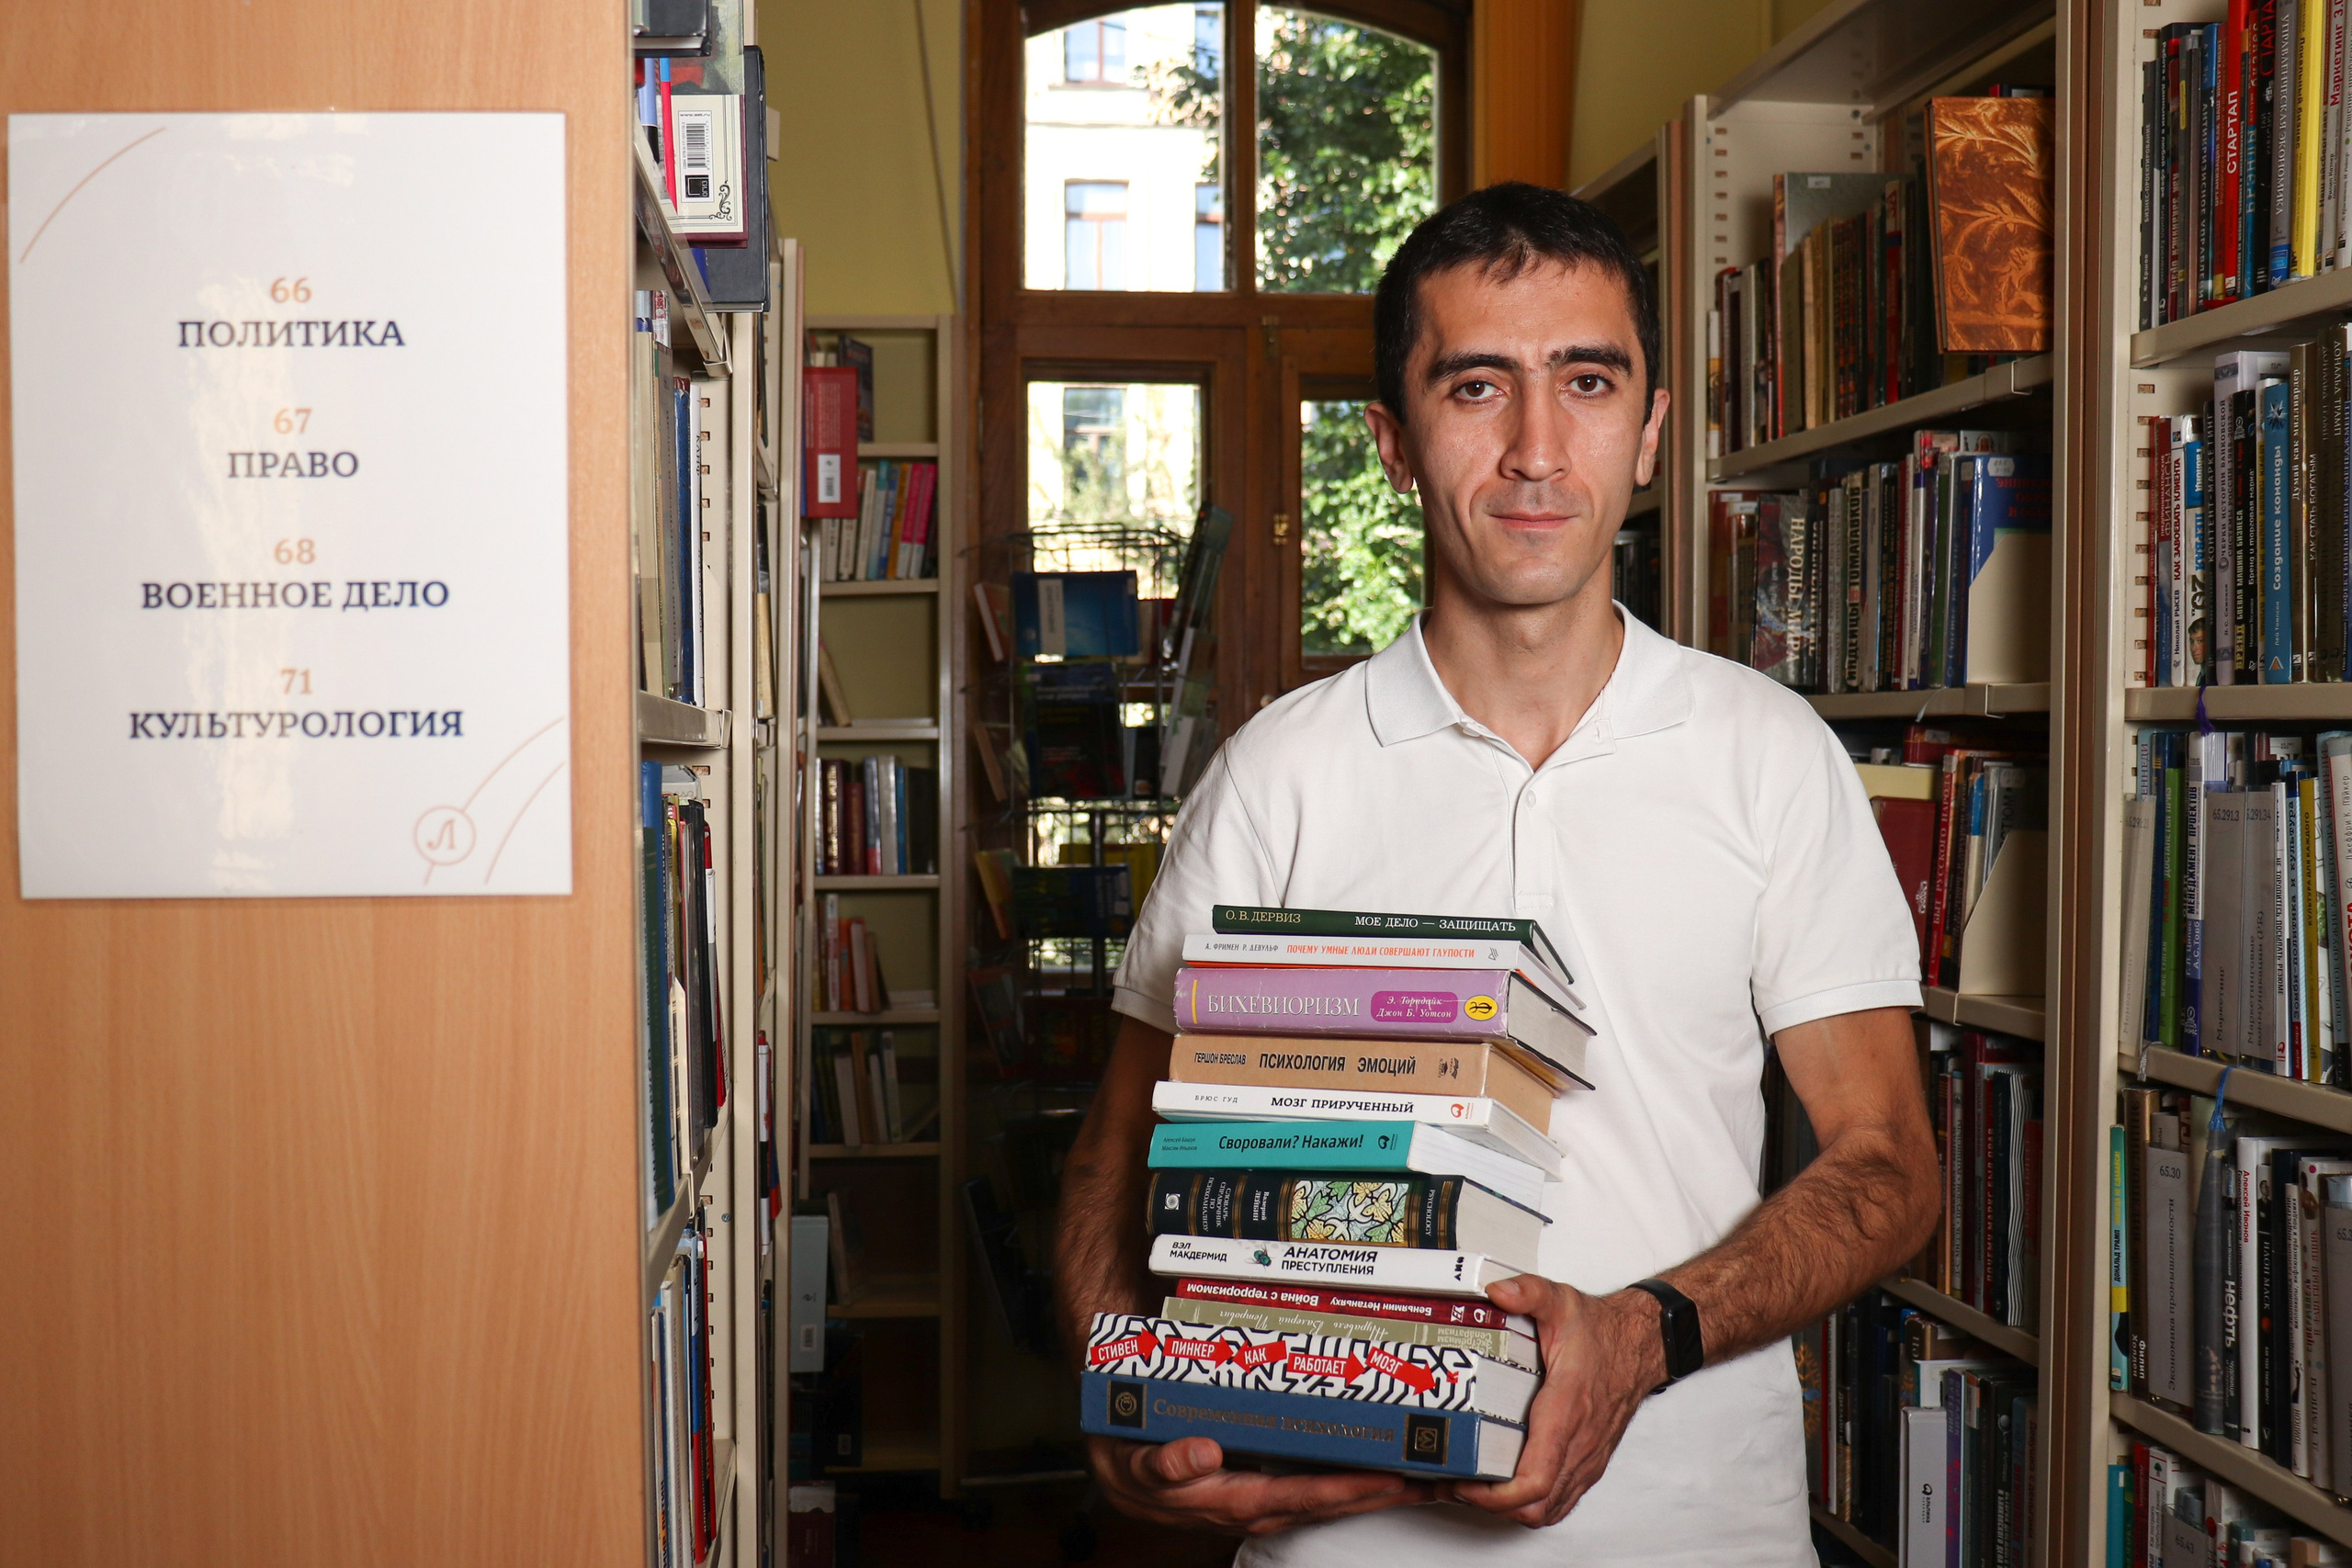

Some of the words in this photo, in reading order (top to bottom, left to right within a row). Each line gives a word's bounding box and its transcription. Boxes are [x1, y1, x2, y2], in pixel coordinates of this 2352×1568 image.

[2278, 14, 2290, 129] УПРАВЛЕНЧЕСКАЯ
[2329, 24, 2344, 107] Маркетинг
[2227, 90, 2239, 175] СТАРТАП
[2200, 103, 2209, 217] АНТИКРИЗИСНОЕ
[2275, 130, 2288, 216] ЭКОНОМИКА
[2197, 219, 2206, 307] УПРАВЛЕНИЕ
[269, 276, 313, 305] 66
[177, 319, 406, 348] ПОЛИТИКА
[2333, 337, 2343, 396] ДОНАЛЬД
[2291, 368, 2301, 436] миллиардер
[2334, 397, 2342, 437] ТРАМП
[273, 407, 313, 435] 67
[227, 451, 359, 480] ПРАВО
[2273, 445, 2283, 514] команды
[2291, 463, 2301, 501] Думай
[2309, 453, 2317, 504] БОГАТЫМ
[2343, 403, 2351, 526] БРЕНД-МЕНЕДЖМЕНТ
[2164, 453, 2172, 536] ФИНАНСЫ
[2206, 413, 2215, 562] КОНТЕНТ-МАРКЕТИНГ
[1849, 486, 1860, 588] ТОМАГАВКОВ
[2235, 509, 2244, 547] БИЗНЕСА
[2309, 504, 2317, 538] СТАТЬ
[274, 537, 317, 566] 68
[1786, 517, 1805, 602] НАРОДЫ
[2235, 548, 2244, 587] МАШИНА
[2272, 519, 2284, 591] Создание
[2308, 539, 2316, 560] КАК
[2247, 556, 2256, 585] Бренд
[2342, 527, 2350, 617] ЭФФЕКТИВНЫЙ
[141, 581, 334, 610] ВОЕННОЕ
[341, 581, 449, 613] ДЕЛО
[2235, 588, 2244, 620] БОЕВАЯ
[1786, 607, 1802, 663] МИРА
[1848, 603, 1860, 681] ИНДЕЙЦЫ
[2234, 624, 2243, 671] БРЕНД
[279, 668, 314, 696] 71
[129, 710, 465, 740] КУЛЬТУРОЛОГИЯ
[1940, 773, 1951, 823] НАРОДА
[2164, 786, 2172, 813] ПРИЗ
[2322, 749, 2333, 818] КЕННЕДИ
[2342, 775, 2351, 807] Лайкер
[2188, 785, 2197, 837] ПРОЕКТОВ
[2212, 808, 2240, 822] 65.291.3
[2163, 814, 2172, 878] ДОСТАНЕТСЯ
[2288, 801, 2297, 872] культура
[2303, 811, 2312, 855] КАЖДОГО
[2343, 819, 2352, 861] Джеффри
[1935, 827, 1948, 893] РУССКОГО
[2327, 822, 2338, 908] МАРКЕТОЛОГА
[2187, 843, 2196, 915] МЕНЕДЖМЕНТ
[2275, 870, 2283, 918] ТОРОПИТЕСЬ
[1225, 910, 1238, 921] О.
[1239, 911, 1250, 922] В.
[1251, 911, 1301, 924] ДЕРВИЗ
[1354, 916, 1383, 928] МОЕ
[1385, 917, 1419, 930] ДЕЛО
[1439, 919, 1516, 933] ЗАЩИЩАТЬ
[1932, 898, 1942, 926] БЫТ
[2256, 910, 2265, 940] (PR)
[1213, 943, 1240, 952] ФРИМЕН
[1249, 943, 1279, 953] ДЕВУЛЬФ
[1286, 944, 1318, 954] ПОЧЕМУ
[1321, 944, 1349, 955] УМНЫЕ
[1351, 946, 1377, 957] ЛЮДИ
[1379, 946, 1430, 958] СОВЕРШАЮТ
[1432, 947, 1475, 959] ГЛУПОСТИ
[2276, 919, 2284, 961] ПОСЫЛАТЬ
[2331, 912, 2340, 960] ОРУЖИЕ
[2290, 895, 2301, 1019] Зомби-политика
[2247, 935, 2256, 1044] Маркетинговые
[2276, 964, 2284, 994] РЕЗЮМЕ
[1207, 995, 1360, 1018] БИХЕВИОРИЗМ
[1376, 1007, 1403, 1020] Джон
[1406, 1008, 1416, 1018] Б.
[1419, 1008, 1453, 1020] Уотсон
[1387, 996, 1396, 1006] Э.
[2216, 966, 2225, 1042] Маркетинг
[2334, 964, 2342, 1032] СЕКРЕТНОЕ
[1193, 1052, 1219, 1064] ГЕРШОН
[1219, 1053, 1247, 1066] БРЕСЛАВ
[1259, 1053, 1346, 1072] ПСИХОЛОГИЯ
[1357, 1055, 1417, 1077] ЭМОЦИЙ
[1194, 1094, 1218, 1102] БРЮС
[1222, 1095, 1238, 1104] ГУД
[1270, 1096, 1307, 1108] МОЗГ
[1311, 1097, 1414, 1114] ПРИРУЧЕННЫЙ
[1218, 1134, 1299, 1150] Своровали?
[1301, 1134, 1364, 1149] Накажи!
[2159, 1165, 2181, 1179] 65.30
[1202, 1177, 1215, 1232] ПСИХОАНАЛИЗУ
[1209, 1197, 1216, 1209] ПО
[1216, 1181, 1227, 1228] СПРАВОЧНИК
[1223, 1187, 1232, 1223] СЛОВАРЬ-
[1252, 1190, 1261, 1222] ЛЕЙБИН
[1261, 1191, 1270, 1222] Валерий
[1425, 1189, 1436, 1236] PSYCHOLOGY
[1170, 1248, 1227, 1262] МАКДЕРМИД
[1172, 1241, 1191, 1249] ВЭЛ
[1283, 1246, 1378, 1263] АНАТОМИЯ
[2167, 1198, 2176, 1314] промышленности
[2262, 1241, 2270, 1277] ИЛОН
[1281, 1259, 1374, 1276] ПРЕСТУПЛЕНИЯ
[2113, 1251, 2121, 1282] ДОНАЛЬД
[1186, 1282, 1270, 1299] терроризмом
[1271, 1290, 1278, 1301] с
[1281, 1291, 1319, 1307] Война
[1329, 1296, 1381, 1313] Нетаньяху
[1218, 1309, 1270, 1330] Петрович
[1277, 1314, 1325, 1336] Валерий
[1382, 1302, 1432, 1317] Беньямин
[2222, 1280, 2239, 1348] нефть
[1332, 1320, 1390, 1342] Журавель
[1436, 1327, 1492, 1341] Сепаратизм
[1436, 1335, 1492, 1348] Экстремизм
[1097, 1340, 1139, 1360] СТИВЕН
[1170, 1340, 1216, 1359] ПИНКЕР
[1243, 1348, 1267, 1366] КАК
[1293, 1357, 1347, 1375] РАБОТАЕТ
[1369, 1348, 1404, 1375] МОЗГ
[2139, 1339, 2147, 1380] Филип
[2168, 1317, 2177, 1392] Экономика
[1152, 1398, 1277, 1429] Современная
[1281, 1416, 1396, 1442] психология
[2028, 1420, 2038, 1472] Девушка
[2175, 1534, 2195, 1554] 65.43
